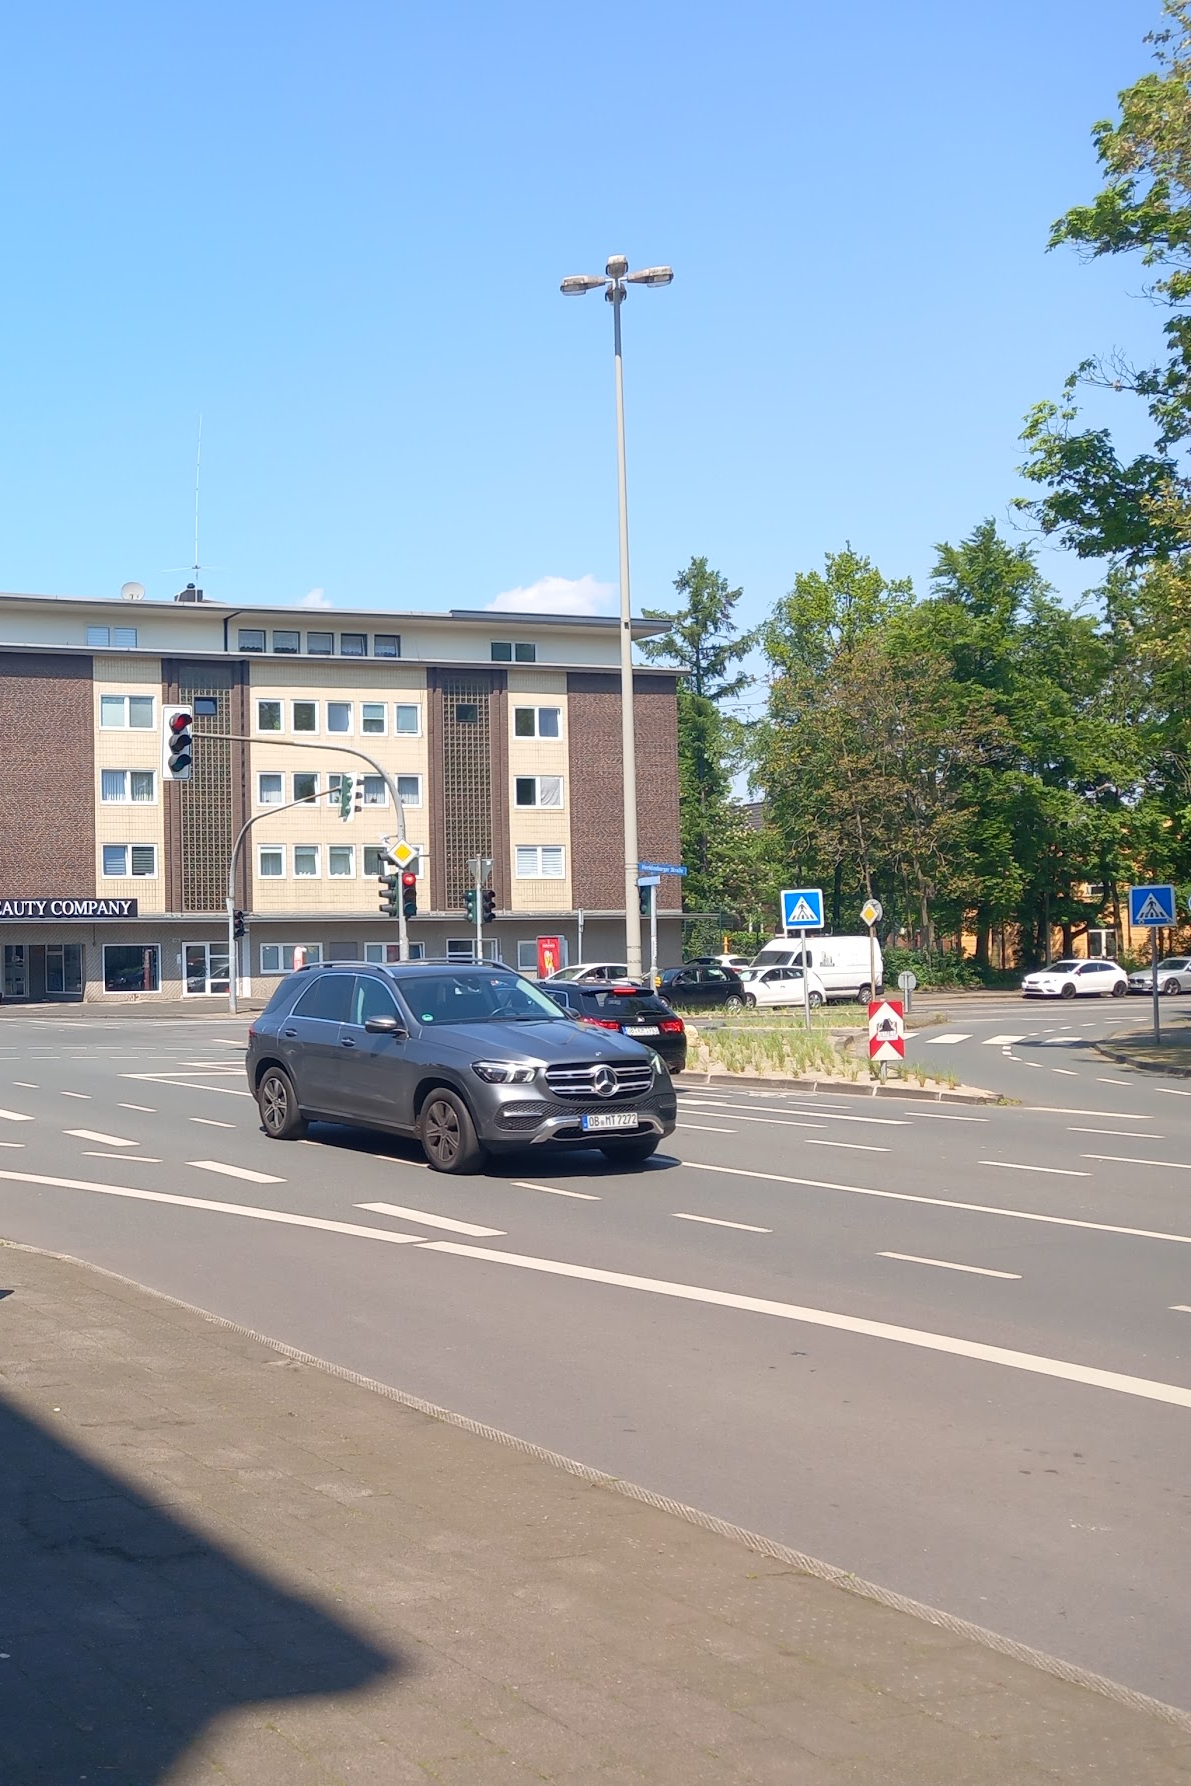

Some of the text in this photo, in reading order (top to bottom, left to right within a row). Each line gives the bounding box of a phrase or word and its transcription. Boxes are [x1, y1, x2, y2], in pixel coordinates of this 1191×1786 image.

[51, 900, 132, 916] COMPANY
[589, 1113, 637, 1127] OB MT 7272
